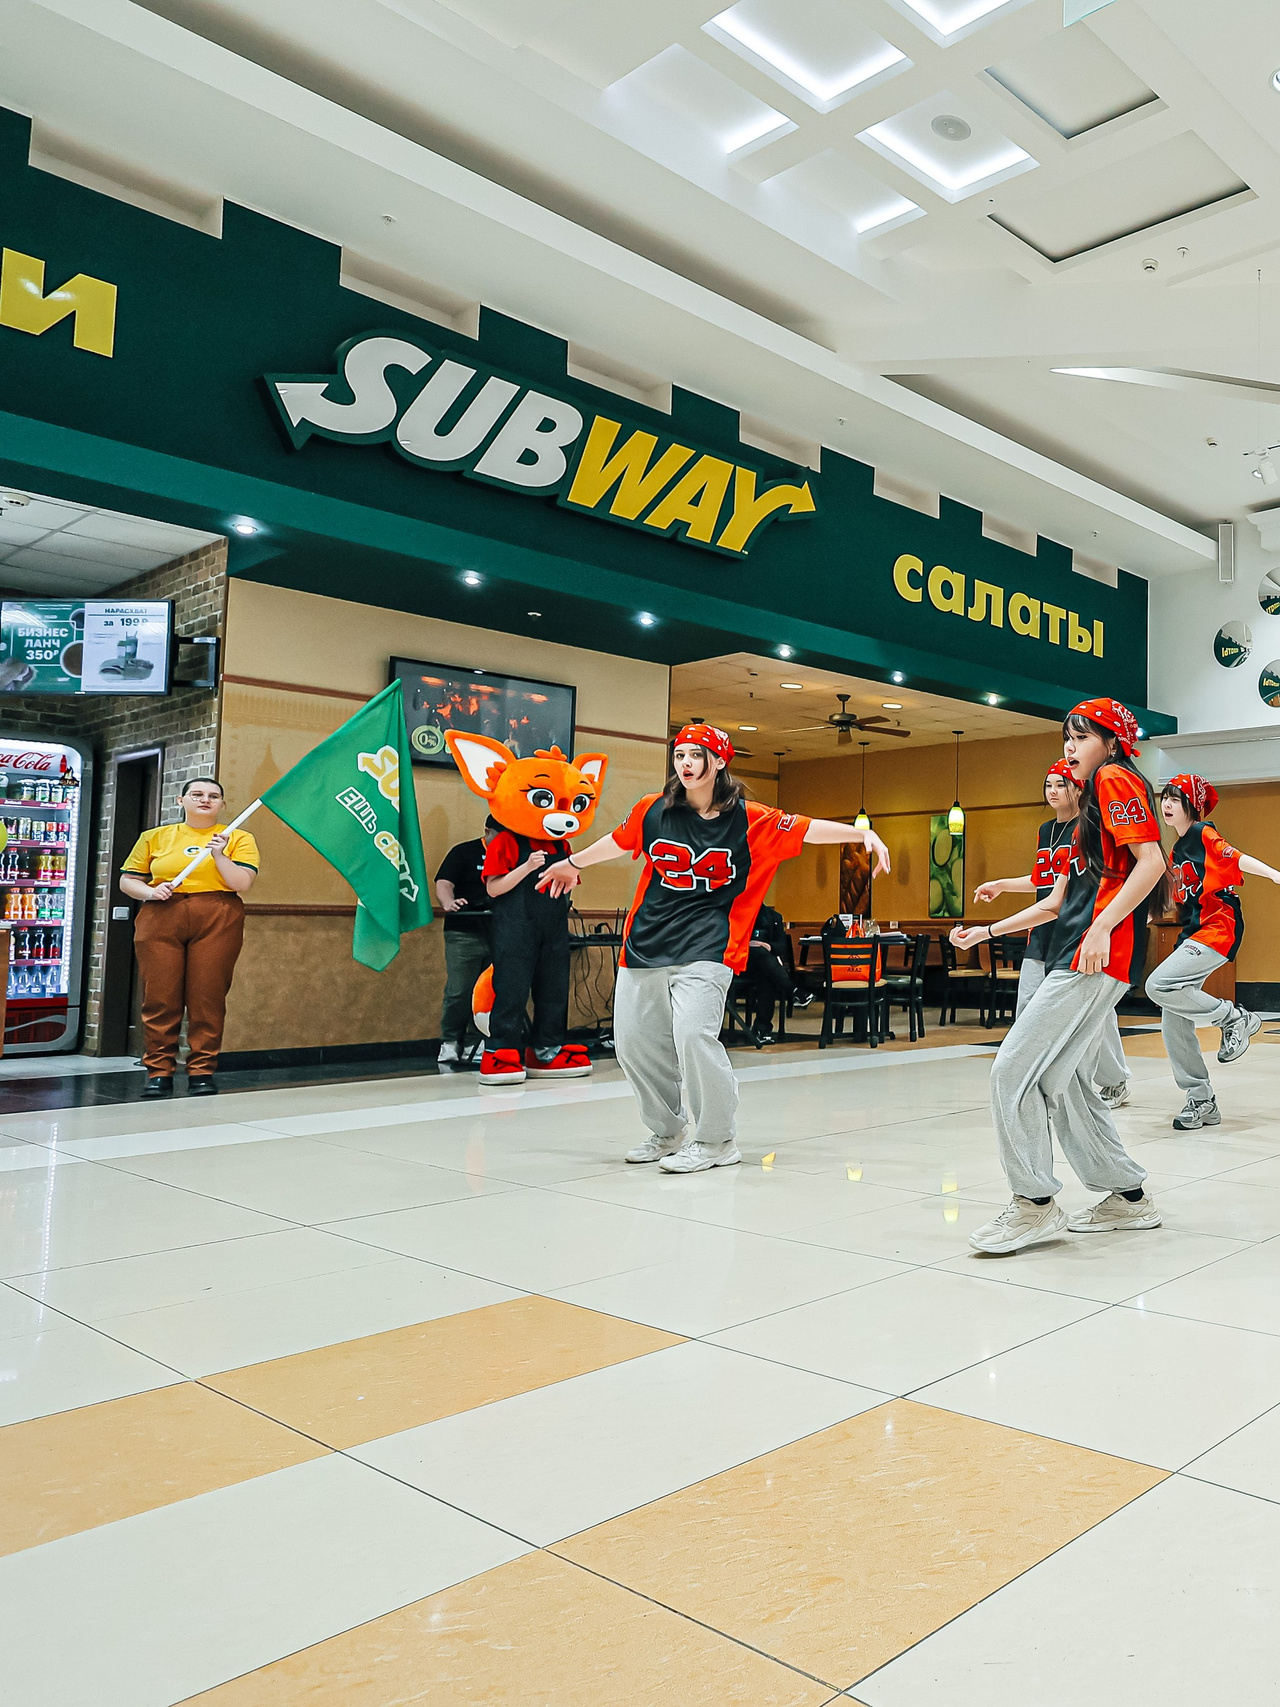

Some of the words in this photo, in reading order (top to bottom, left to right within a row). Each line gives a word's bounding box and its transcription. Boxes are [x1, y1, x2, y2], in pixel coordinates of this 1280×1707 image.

[275, 337, 816, 553] SUBWAY
[892, 553, 1104, 658] салаты
[17, 627, 69, 637] БИЗНЕС
[24, 638, 60, 648] ЛАНЧ
[1108, 797, 1148, 827] 24
[649, 838, 737, 892] 24
